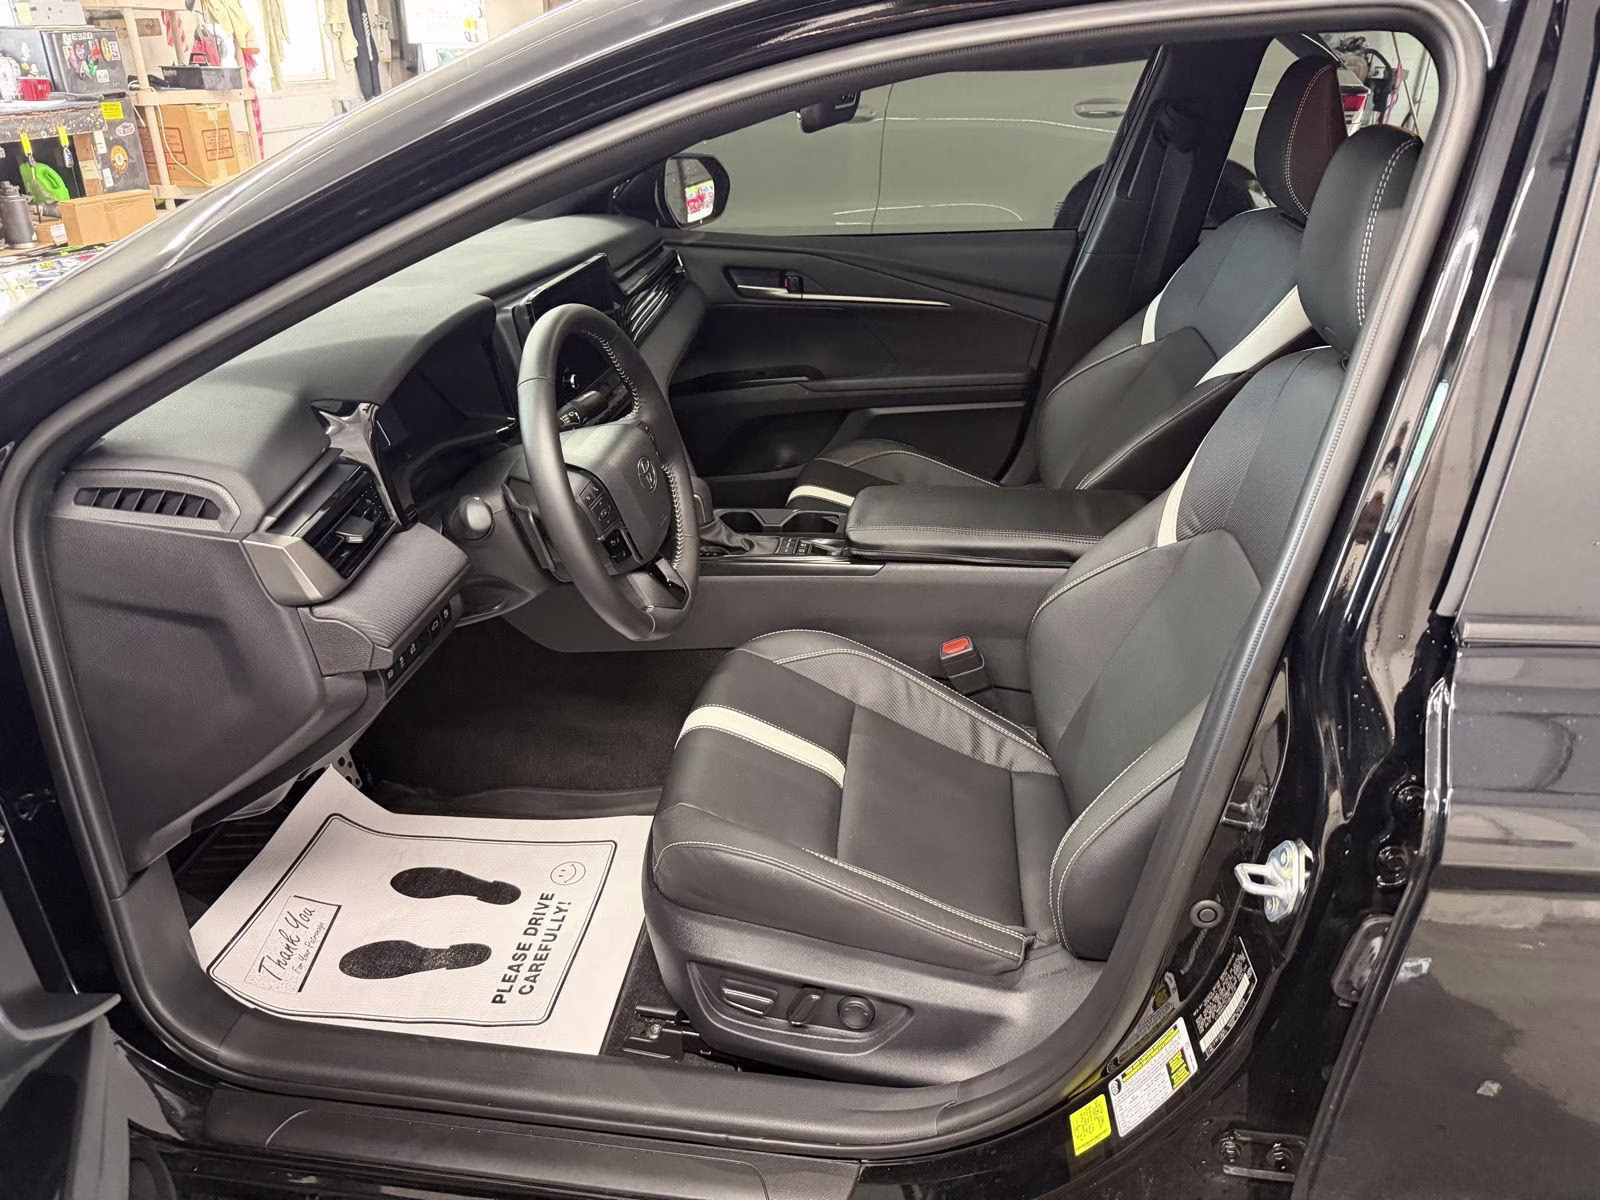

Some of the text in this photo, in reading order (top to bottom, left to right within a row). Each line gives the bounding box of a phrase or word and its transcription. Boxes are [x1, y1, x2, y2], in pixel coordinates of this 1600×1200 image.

[258, 907, 316, 981] Thank You
[491, 893, 555, 1004] PLEASE DRIVE
[518, 901, 572, 995] CAREFULLY!
